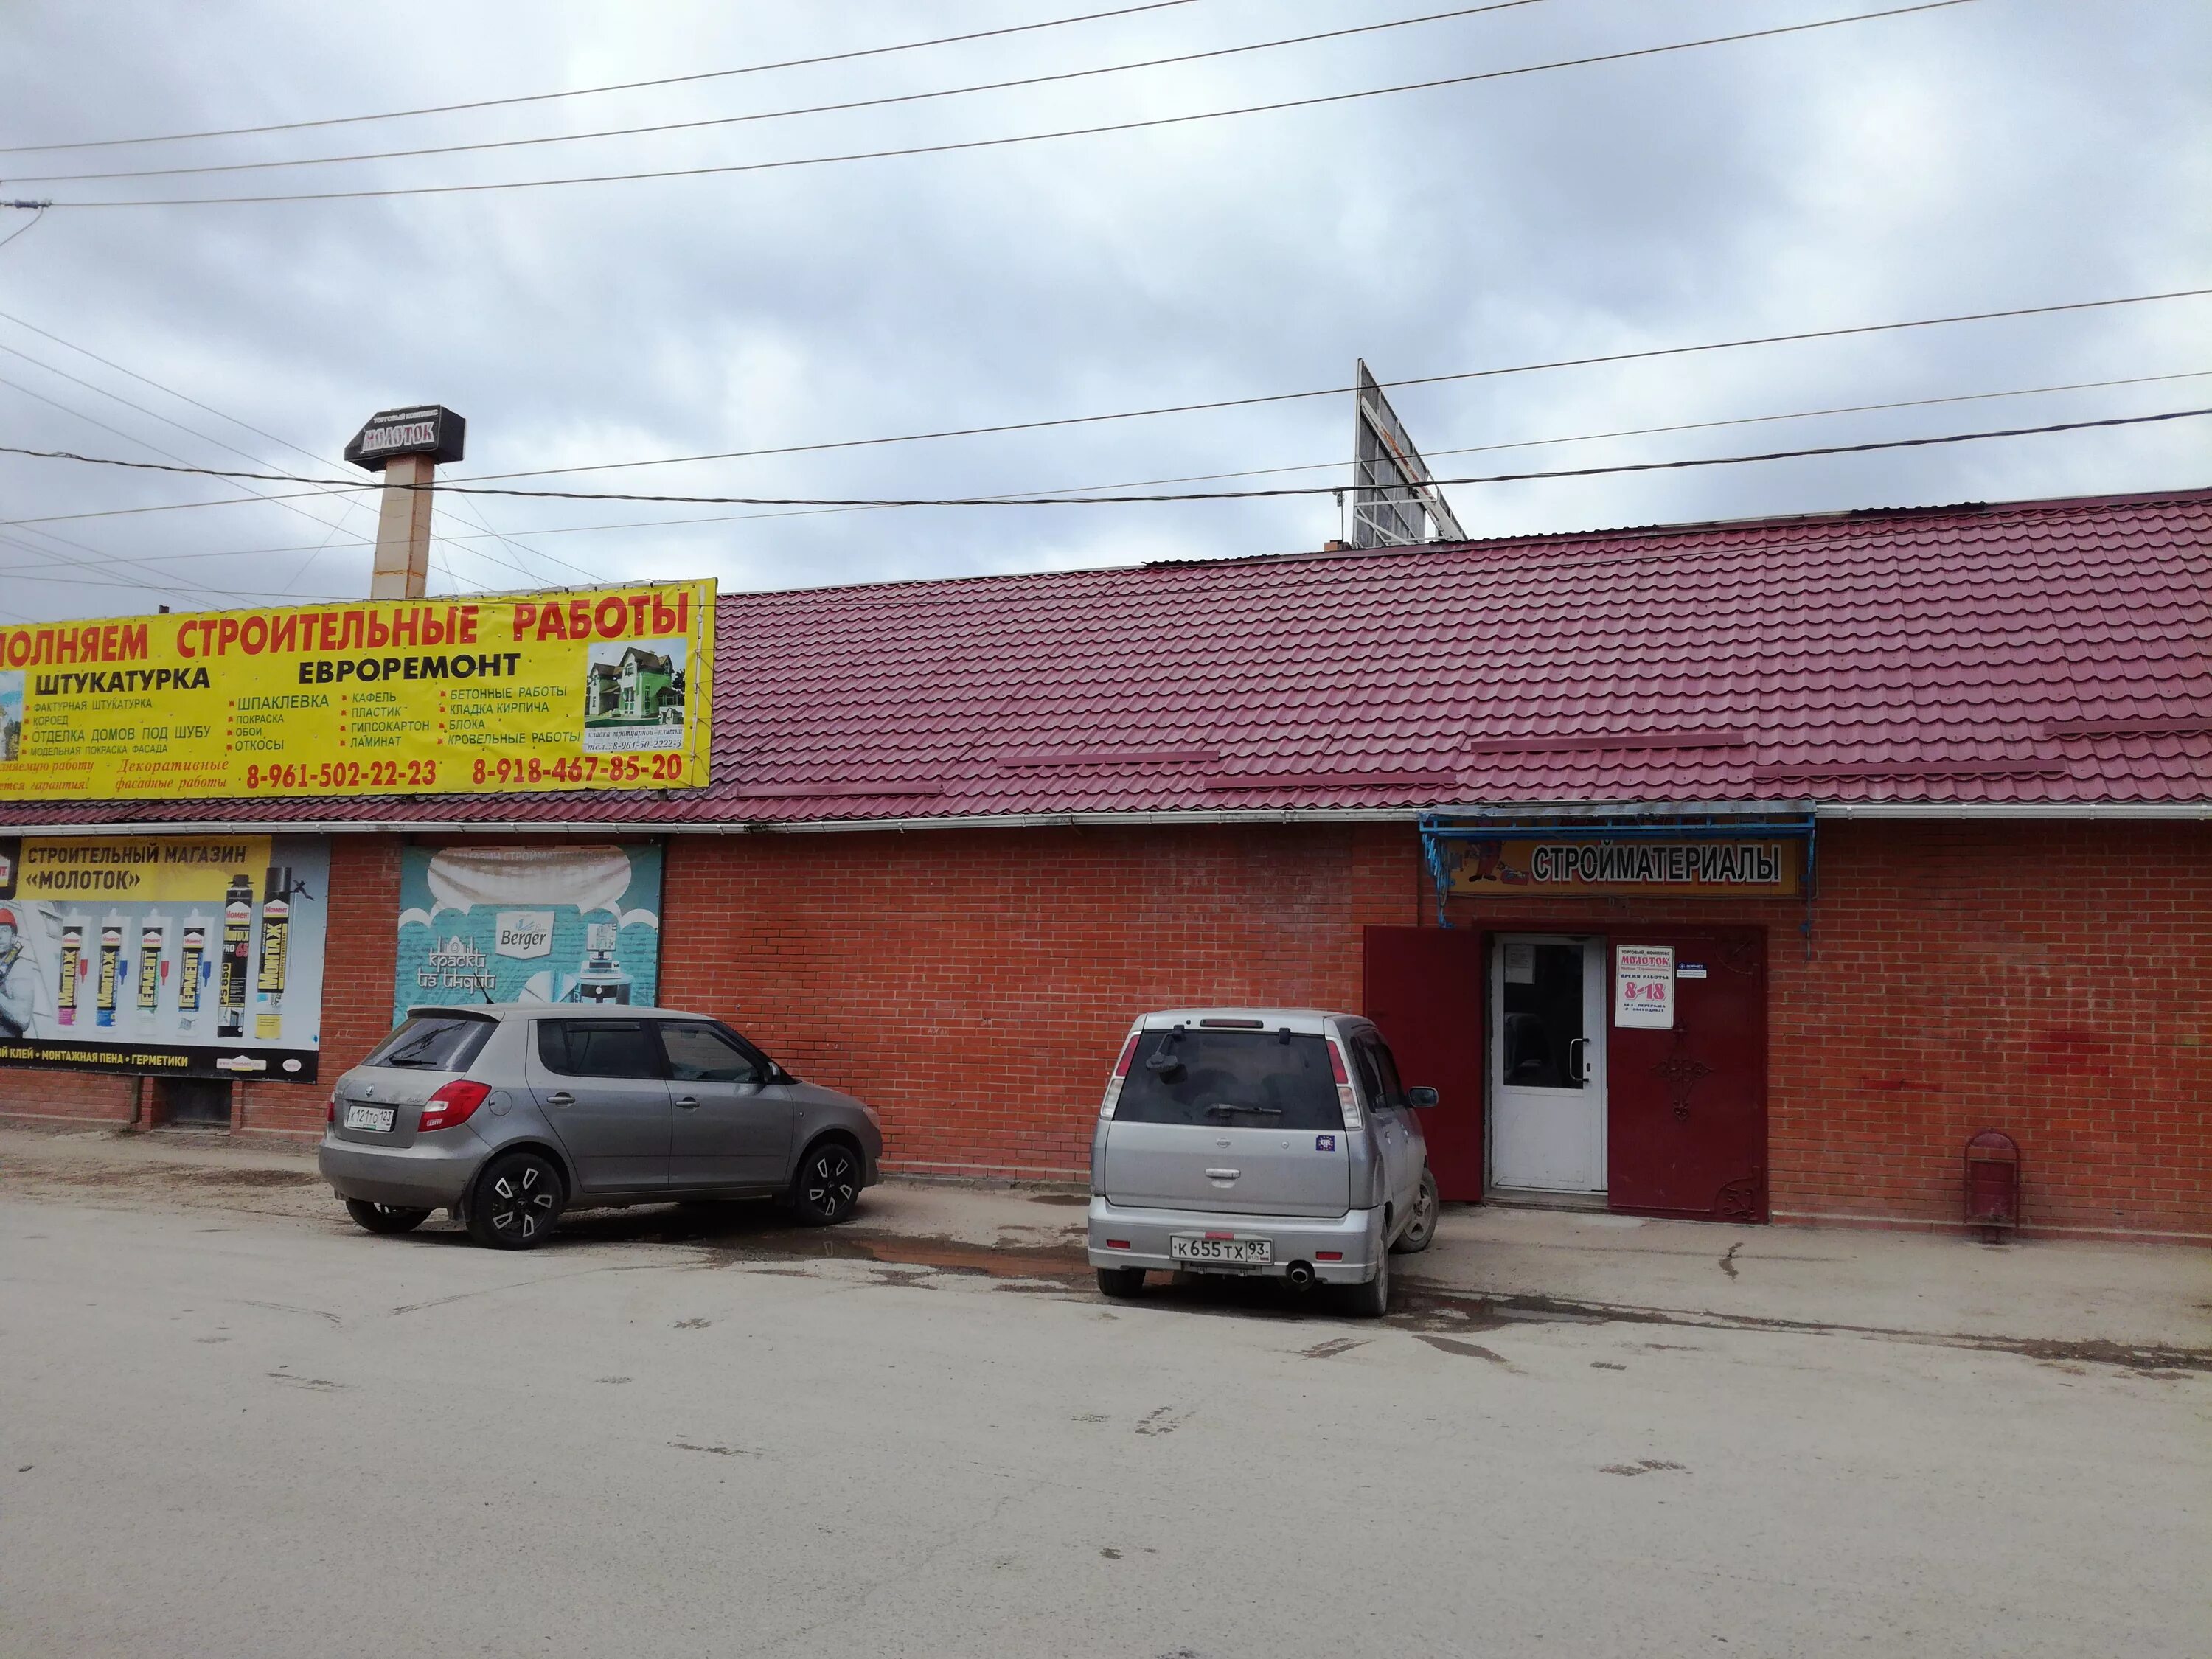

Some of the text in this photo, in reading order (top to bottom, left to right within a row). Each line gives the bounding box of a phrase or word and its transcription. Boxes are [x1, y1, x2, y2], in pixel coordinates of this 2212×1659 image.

[363, 421, 434, 452] МОЛОТОК
[176, 605, 479, 658] СТРОИТЕЛЬНЫЕ
[513, 592, 688, 642] РАБОТЫ
[299, 653, 521, 684] ЕВРОРЕМОНТ
[35, 667, 211, 695] ШТУКАТУРКА
[352, 692, 396, 703] КАФЕЛЬ
[451, 686, 567, 700] БЕТОННЫЕ РАБОТЫ
[34, 698, 152, 712] ФАКТУРНАЯ ШТУКАТУРКА
[238, 695, 329, 711] ШПАКЛЕВКА
[450, 702, 549, 715] КЛАДКА КИРПИЧА
[236, 714, 284, 724] ПОКРАСКА
[352, 706, 401, 718] ПЛАСТИК
[33, 716, 69, 726] КОРОЕД
[351, 720, 429, 733] ГИПСОКАРТОН
[449, 720, 485, 730] БЛОКА
[32, 726, 211, 743] ОТДЕЛКА ДОМОВ ПОД ШУБУ
[235, 728, 262, 737] ОБОИ
[448, 731, 580, 745] КРОВЕЛЬНЫЕ РАБОТЫ
[235, 740, 284, 751] ОТКОСЫ
[350, 736, 401, 748] ЛАМИНАТ
[613, 739, 682, 750] 8-961-50-2222-3
[30, 744, 167, 757] МОДЕЛЬНАЯ ПОКРАСКА ФАСАДА
[52, 758, 94, 774] работу
[117, 758, 229, 773] Декоративные
[472, 754, 682, 785] 8-918-467-85-20
[247, 759, 437, 789] 8-961-502-22-23
[31, 778, 89, 793] гарантия!
[115, 775, 227, 792] фасадные работы
[28, 843, 246, 863] СТРОИТЕЛЬНЫЙ МАГАЗИН
[1531, 839, 1781, 883] СТРОЙМАТЕРИАЛЫ
[26, 870, 140, 889] «МОЛОТОК»
[501, 931, 546, 950] Berger
[235, 943, 248, 957] 65
[428, 946, 486, 972] краски
[1621, 956, 1670, 967] МОЛОТОК
[417, 967, 495, 995] из индии
[1624, 981, 1666, 1001] 8-18
[10, 1047, 34, 1059] КЛЕЙ
[42, 1050, 123, 1063] МОНТАЖНАЯ ПЕНА
[132, 1054, 188, 1066] ГЕРМЕТИКИ
[380, 1110, 392, 1121] 123
[1248, 1242, 1265, 1255] 93
